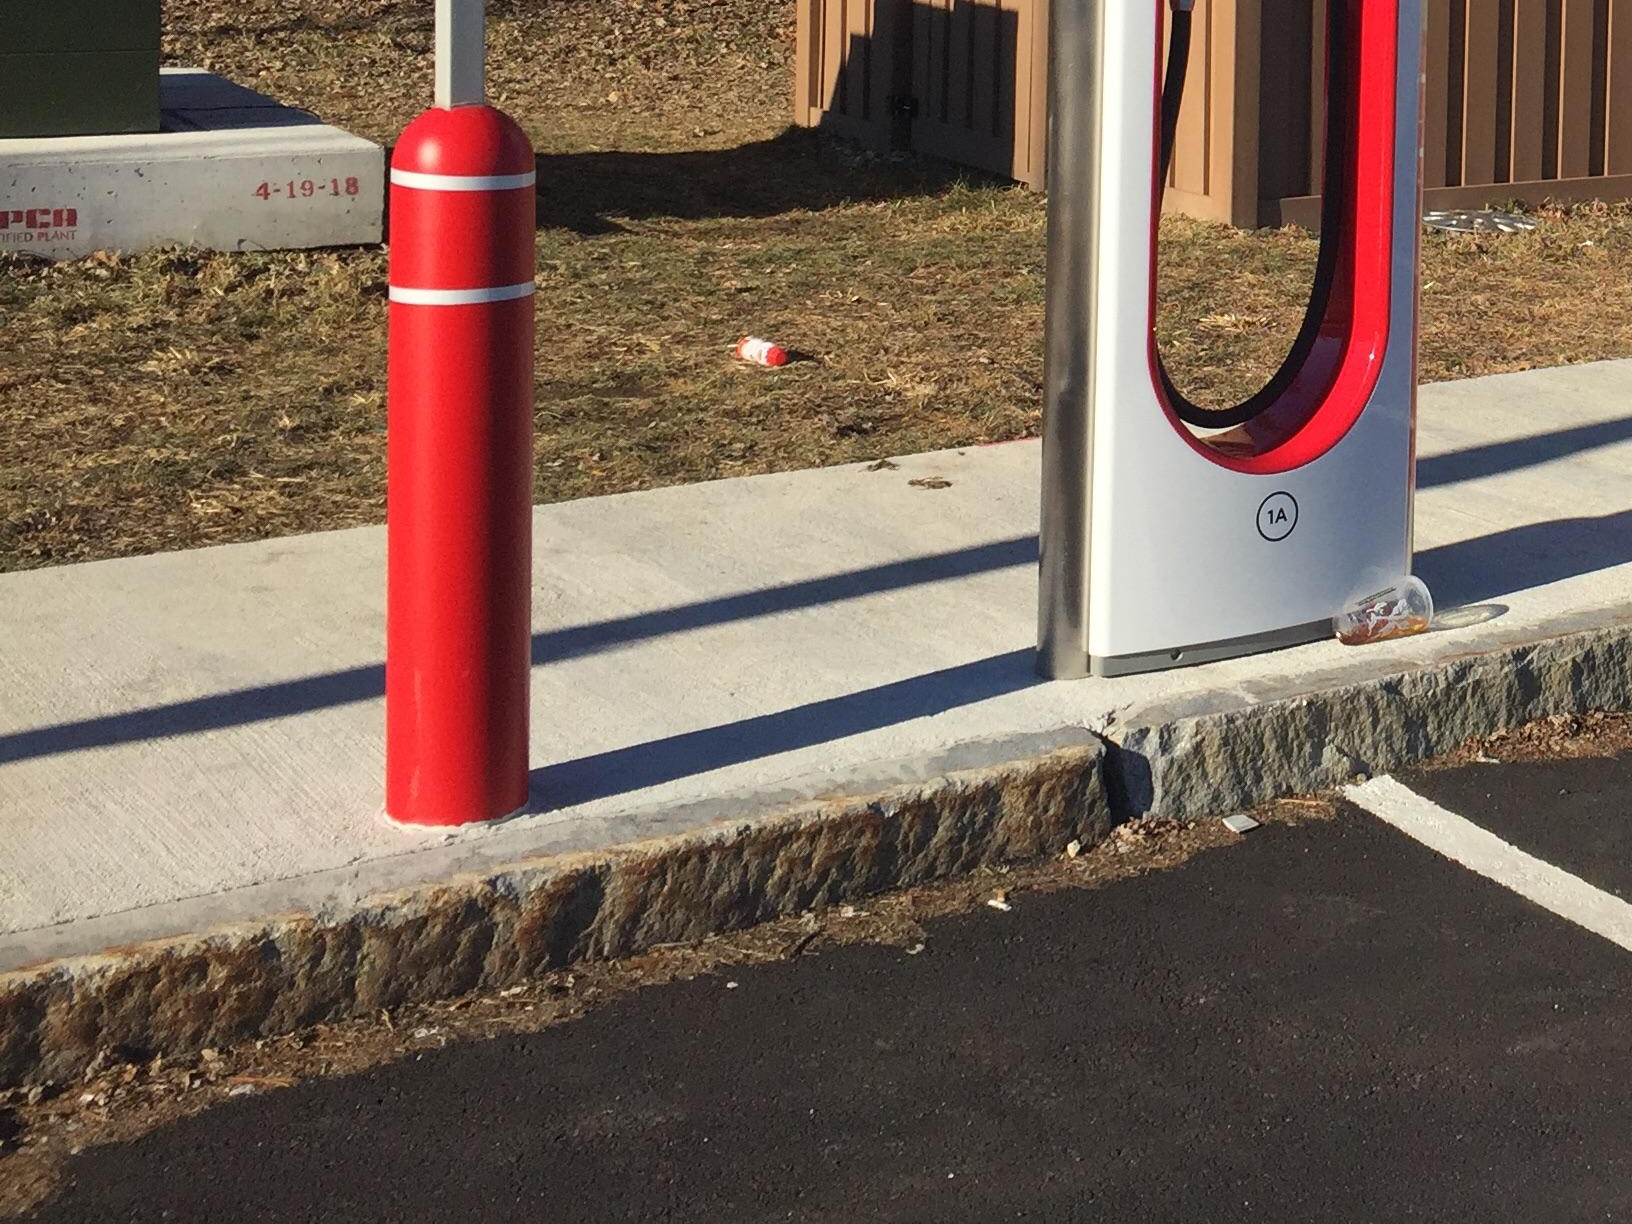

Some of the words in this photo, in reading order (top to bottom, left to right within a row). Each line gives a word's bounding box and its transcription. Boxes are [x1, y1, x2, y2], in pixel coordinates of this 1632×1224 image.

[252, 176, 360, 201] 4-19-18
[36, 229, 77, 242] PLANT
[1267, 507, 1288, 525] 1A
